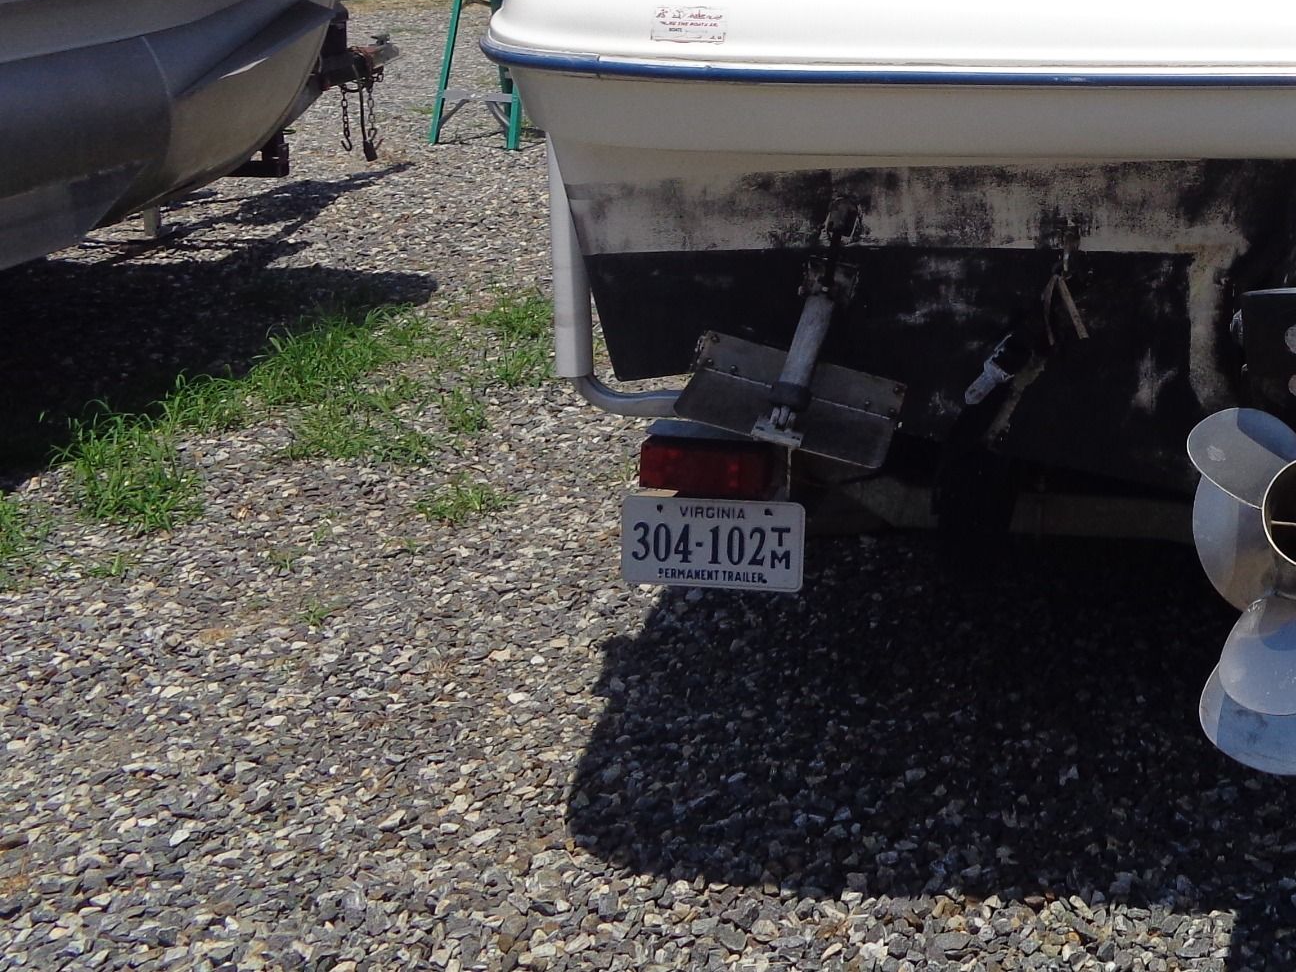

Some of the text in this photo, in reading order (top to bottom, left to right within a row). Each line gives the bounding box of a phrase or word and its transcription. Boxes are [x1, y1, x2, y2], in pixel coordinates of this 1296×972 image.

[679, 506, 746, 520] VIRGINIA
[632, 521, 766, 566] 304-102
[658, 567, 766, 584] PERMANENT TRAILER
